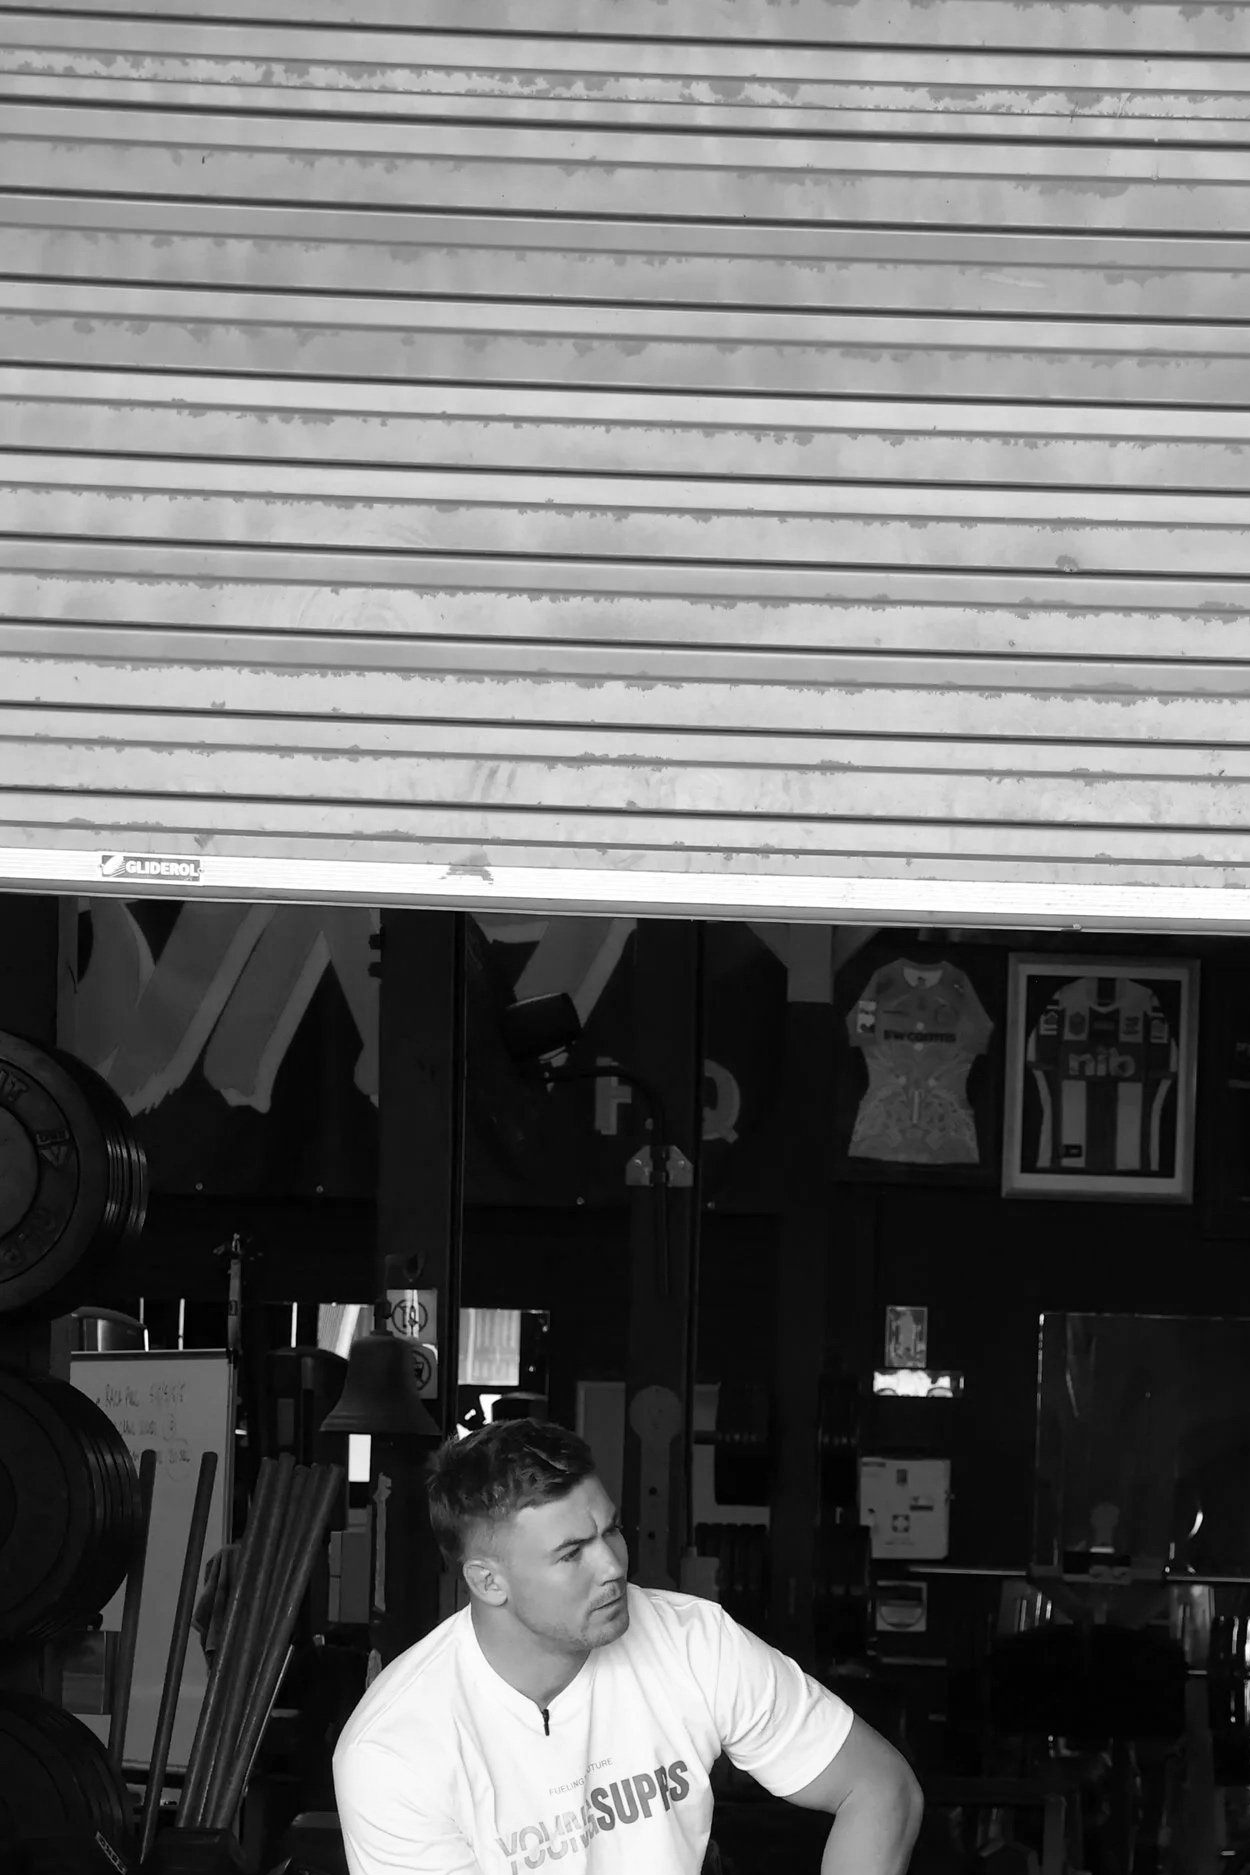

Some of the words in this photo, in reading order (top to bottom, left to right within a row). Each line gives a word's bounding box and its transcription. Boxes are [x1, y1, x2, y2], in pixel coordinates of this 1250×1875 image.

[126, 860, 199, 877] GLIDEROL
[1068, 1046, 1136, 1078] nib
[549, 1777, 585, 1796] FUELING
[584, 1757, 613, 1779] UTURE
